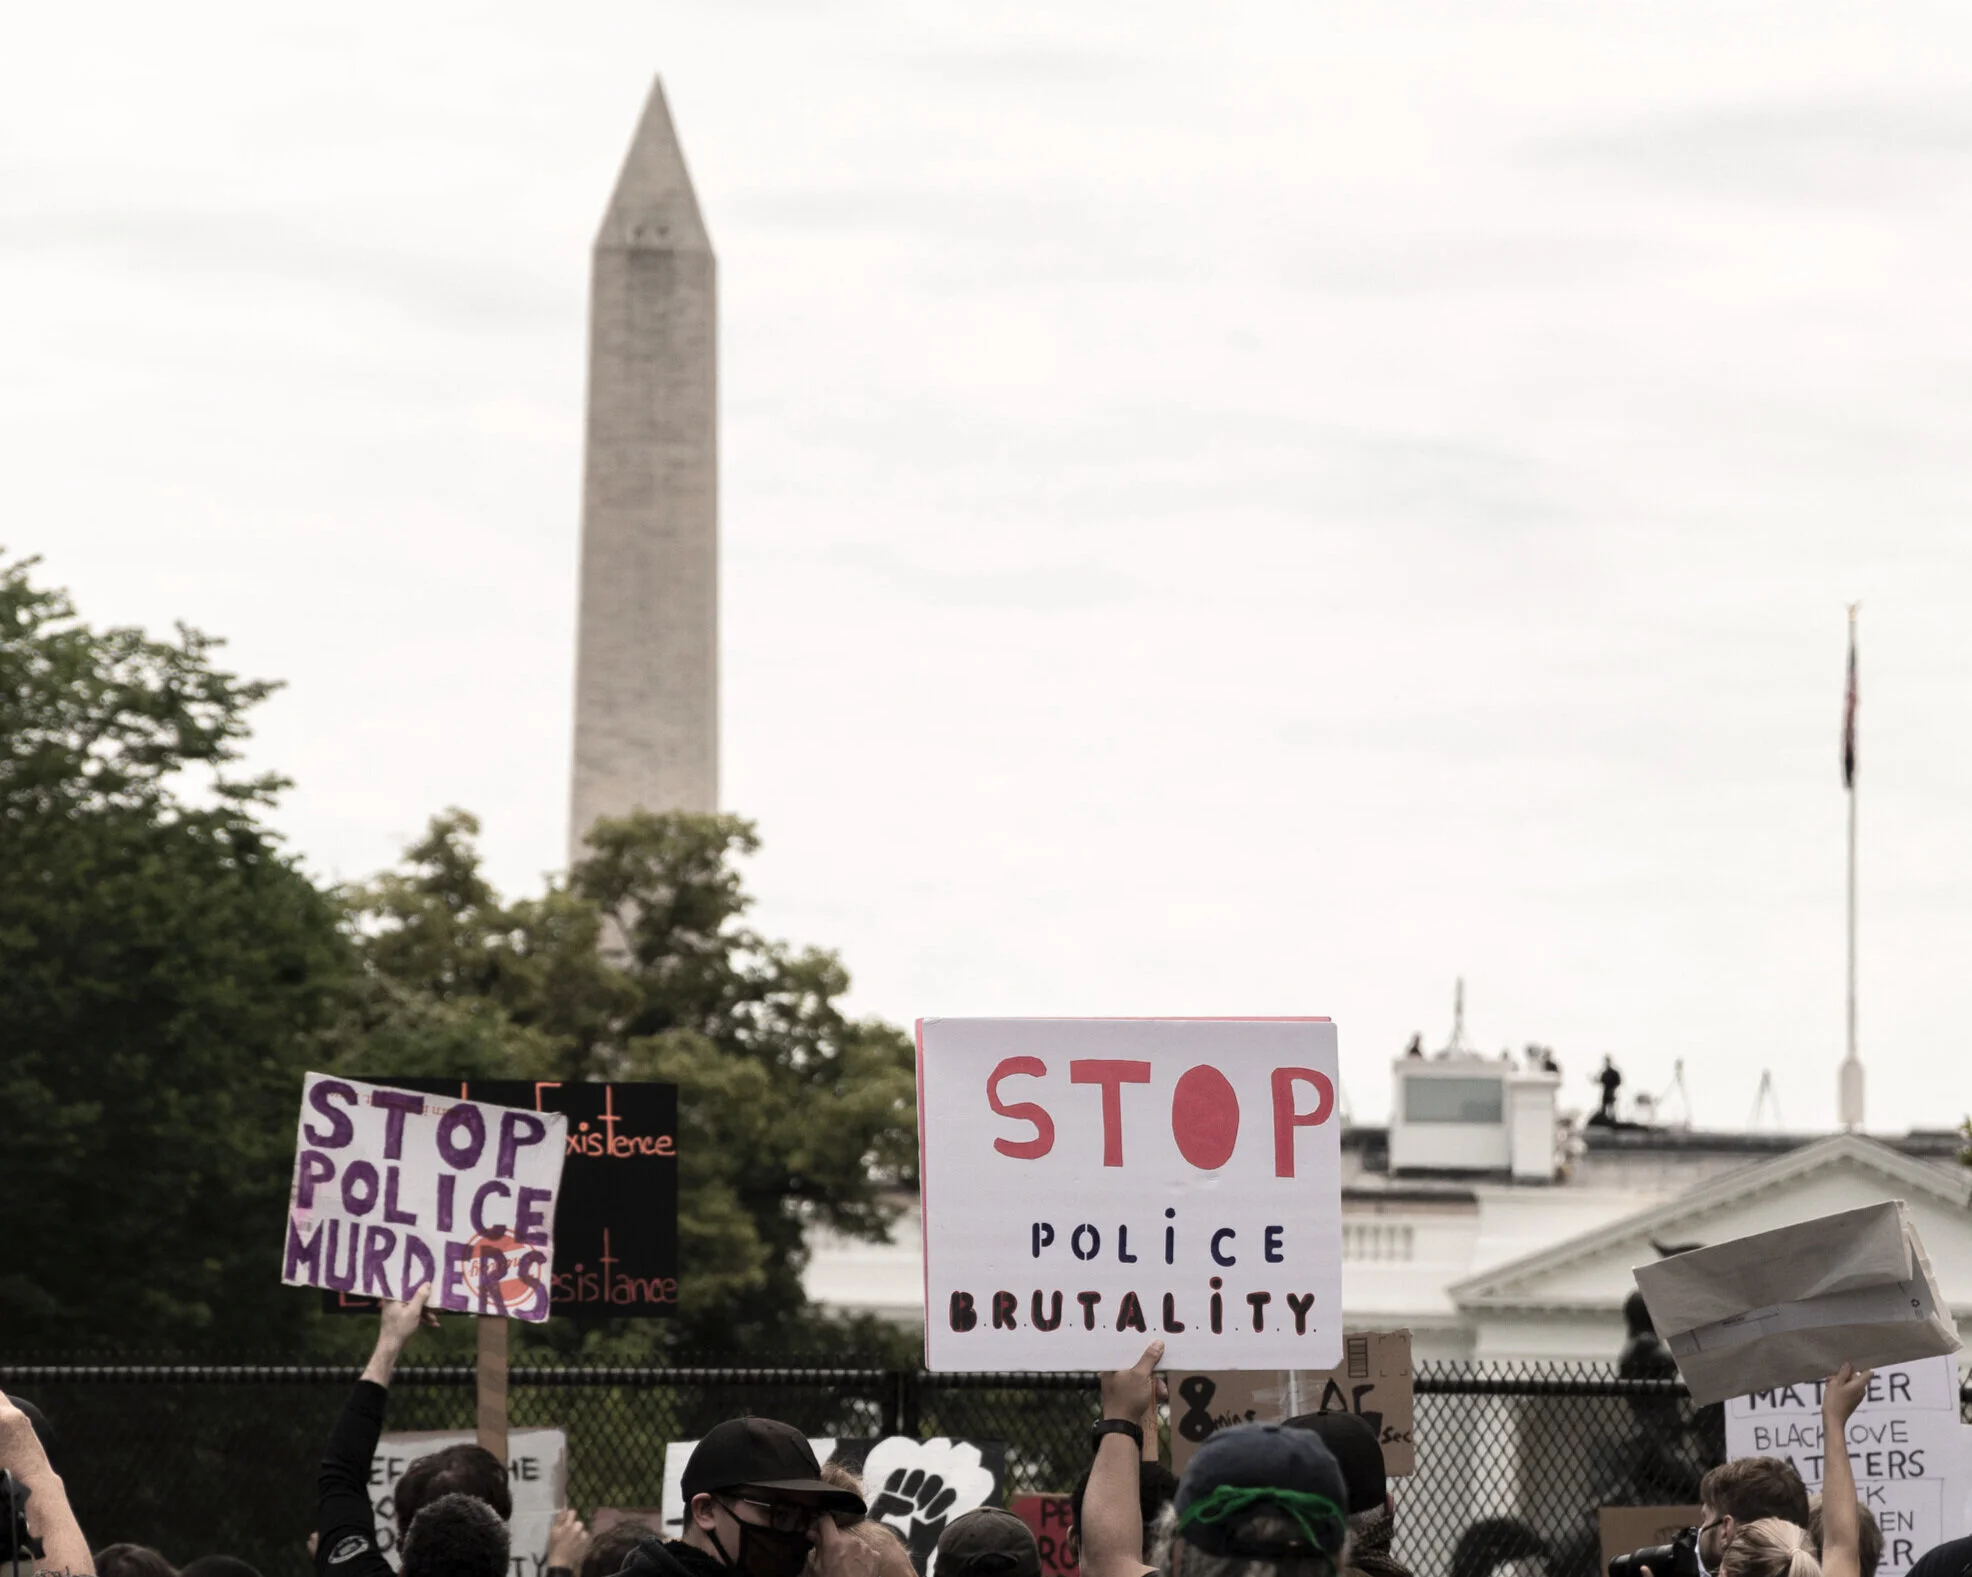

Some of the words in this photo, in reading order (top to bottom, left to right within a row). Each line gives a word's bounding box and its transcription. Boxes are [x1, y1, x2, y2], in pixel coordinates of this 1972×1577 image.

[303, 1079, 547, 1179] STOP
[987, 1056, 1335, 1179] STOP
[295, 1150, 553, 1247] POLICE
[284, 1214, 550, 1321] MURDERS
[1178, 1375, 1217, 1443] 8
